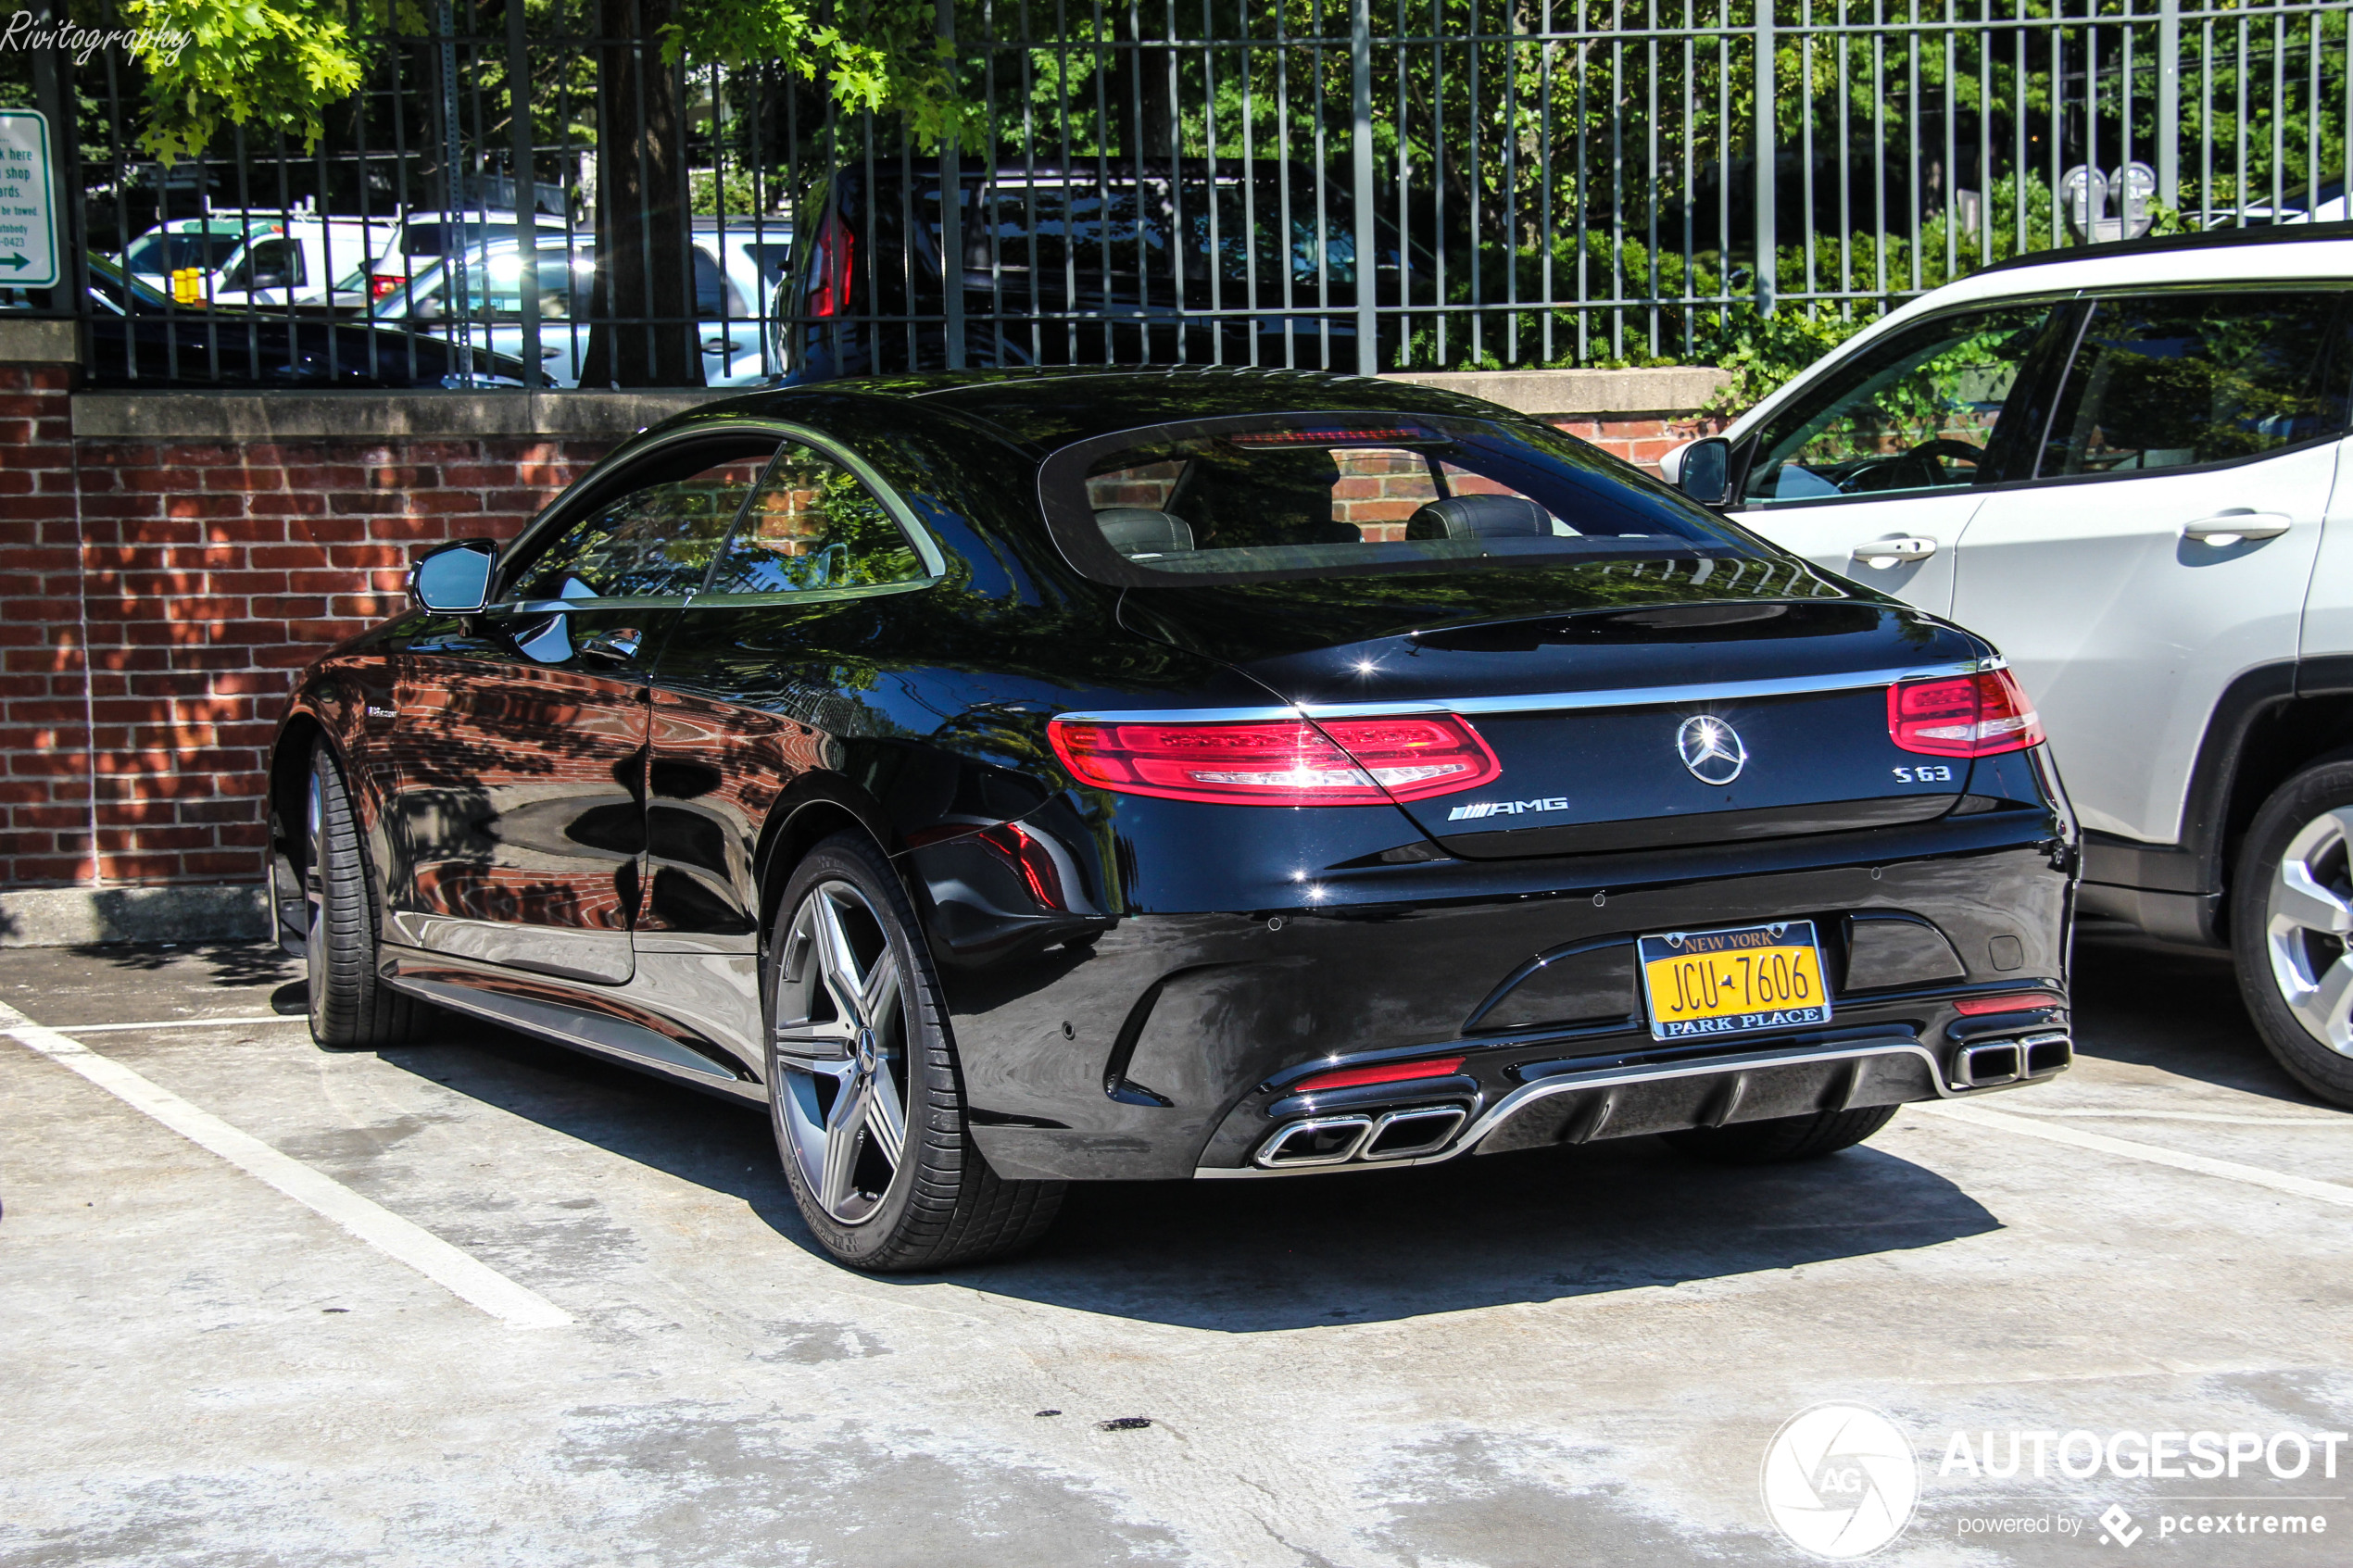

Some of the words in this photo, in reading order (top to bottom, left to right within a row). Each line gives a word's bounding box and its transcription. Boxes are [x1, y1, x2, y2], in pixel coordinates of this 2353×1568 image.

[9, 147, 32, 161] here
[6, 166, 31, 183] shop
[2, 206, 11, 216] be
[1487, 797, 1569, 817] AMG
[1684, 936, 1725, 954] NEW
[1729, 932, 1774, 948] YORK
[1667, 1017, 1734, 1037] PARK
[1740, 1009, 1820, 1029] PLACE
